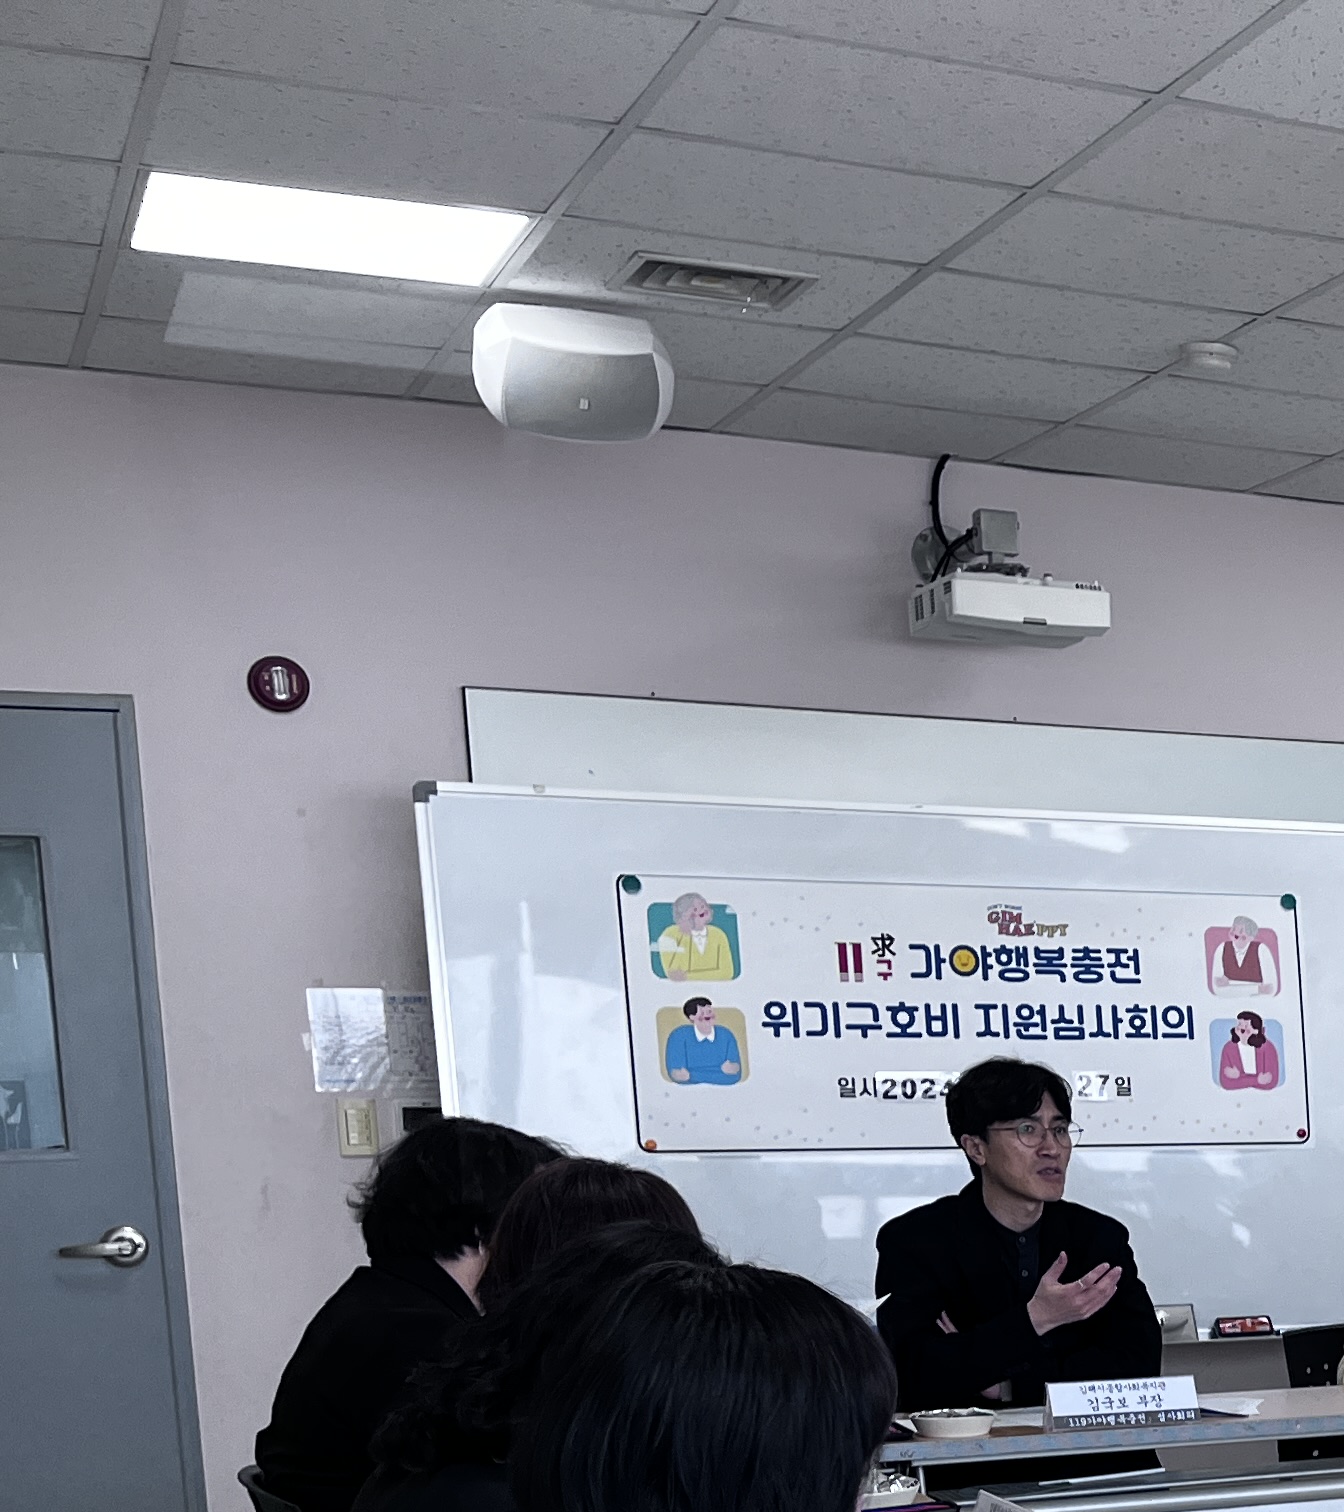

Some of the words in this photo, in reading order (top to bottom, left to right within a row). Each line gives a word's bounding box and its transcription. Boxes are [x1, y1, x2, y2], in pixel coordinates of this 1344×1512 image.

[908, 943, 1142, 984] 가야행복충전
[761, 1001, 960, 1039] 위기구호비
[974, 1003, 1194, 1040] 지원심사회의
[1137, 1394, 1164, 1408] 부장
